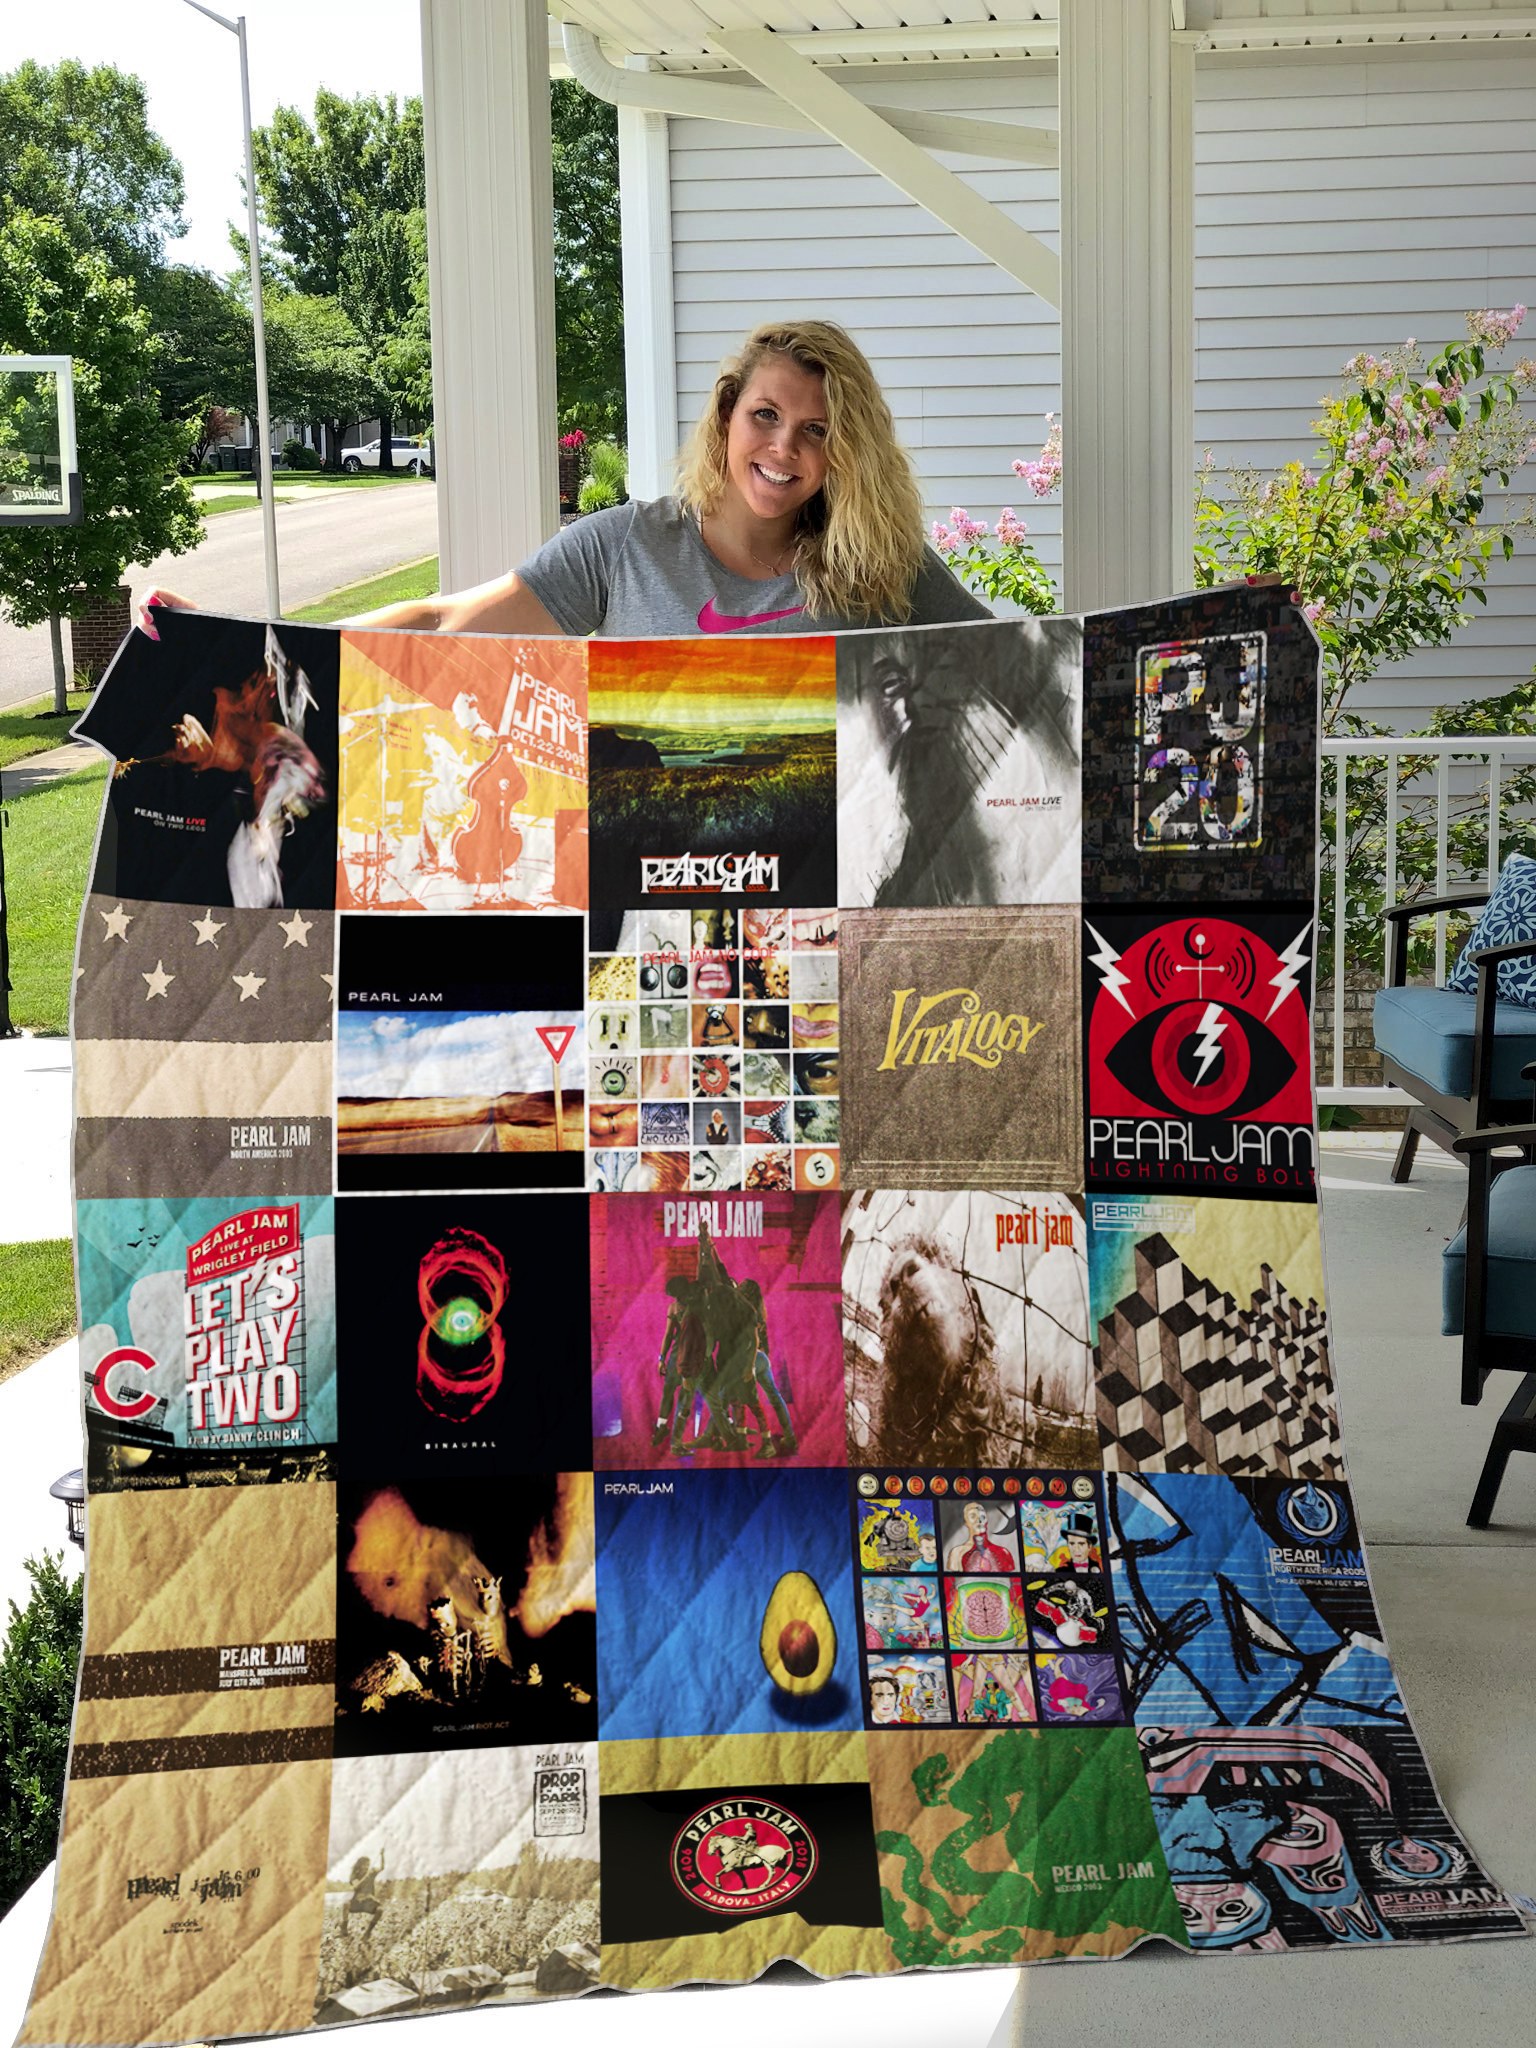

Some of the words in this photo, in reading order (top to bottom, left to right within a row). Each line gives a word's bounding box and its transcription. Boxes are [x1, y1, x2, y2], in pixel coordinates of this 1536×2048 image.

[12, 489, 61, 501] SPALDING
[520, 671, 582, 724] PEARL
[512, 697, 588, 755] JAM
[986, 798, 1017, 807] PEARL
[1020, 797, 1040, 806] JAM
[1042, 796, 1062, 805] LIVE
[134, 807, 164, 820] PEARL
[166, 814, 184, 824] JAM
[186, 817, 206, 826] LIVE
[153, 820, 165, 828] ON
[168, 822, 184, 830] TWO
[640, 852, 724, 893] PEARL
[643, 950, 683, 965] PEARL
[689, 947, 714, 963] JAM
[719, 948, 737, 961] NO
[743, 947, 777, 960] CODE
[348, 992, 400, 1002] PEARL
[409, 993, 443, 1002] JAM
[231, 1125, 277, 1147] PEARL
[282, 1124, 311, 1146] JAM
[1089, 1118, 1210, 1163] PEARL
[1211, 1123, 1315, 1167] JAM
[1090, 1162, 1239, 1183] LIGHTNING
[664, 1201, 722, 1237] PEARL
[724, 1201, 763, 1237] JAM
[1094, 1204, 1152, 1218] PEARL
[192, 1220, 245, 1263] PEARL
[251, 1214, 289, 1229] JAM
[996, 1206, 1038, 1252] pearl
[1045, 1207, 1074, 1253] jam
[220, 1241, 240, 1254] LIVE
[242, 1234, 255, 1246] AT
[192, 1250, 247, 1276] WRIGLEY
[250, 1235, 289, 1257] FIELD
[185, 1311, 299, 1383] PLAY
[185, 1366, 300, 1430] TWO
[256, 1428, 301, 1442] CLINCH
[425, 1441, 497, 1450] BINAURAL
[605, 1483, 644, 1495] PEARL
[646, 1483, 674, 1494] JAM
[1273, 1548, 1325, 1563] PEARL
[1322, 1549, 1363, 1569] JAM
[1275, 1566, 1303, 1574] NORTH
[1304, 1566, 1342, 1575] AMERICA
[1343, 1567, 1366, 1576] 2005
[220, 1647, 269, 1667] PEARL
[274, 1645, 305, 1665] JAM
[495, 1721, 509, 1729] ACT
[536, 1754, 560, 1767] PEARL
[563, 1752, 584, 1765] JAM
[540, 1772, 581, 1789] DROP
[540, 1792, 581, 1803] PARK
[685, 1803, 748, 1842] PEARL
[755, 1807, 799, 1836] JAM
[1051, 1864, 1111, 1883] PEARL
[1117, 1861, 1155, 1880] JAM
[758, 1881, 792, 1902] ITALY
[1380, 1891, 1443, 1905] PEARL
[1444, 1887, 1504, 1905] JAM
[1384, 1906, 1422, 1914] NORTH
